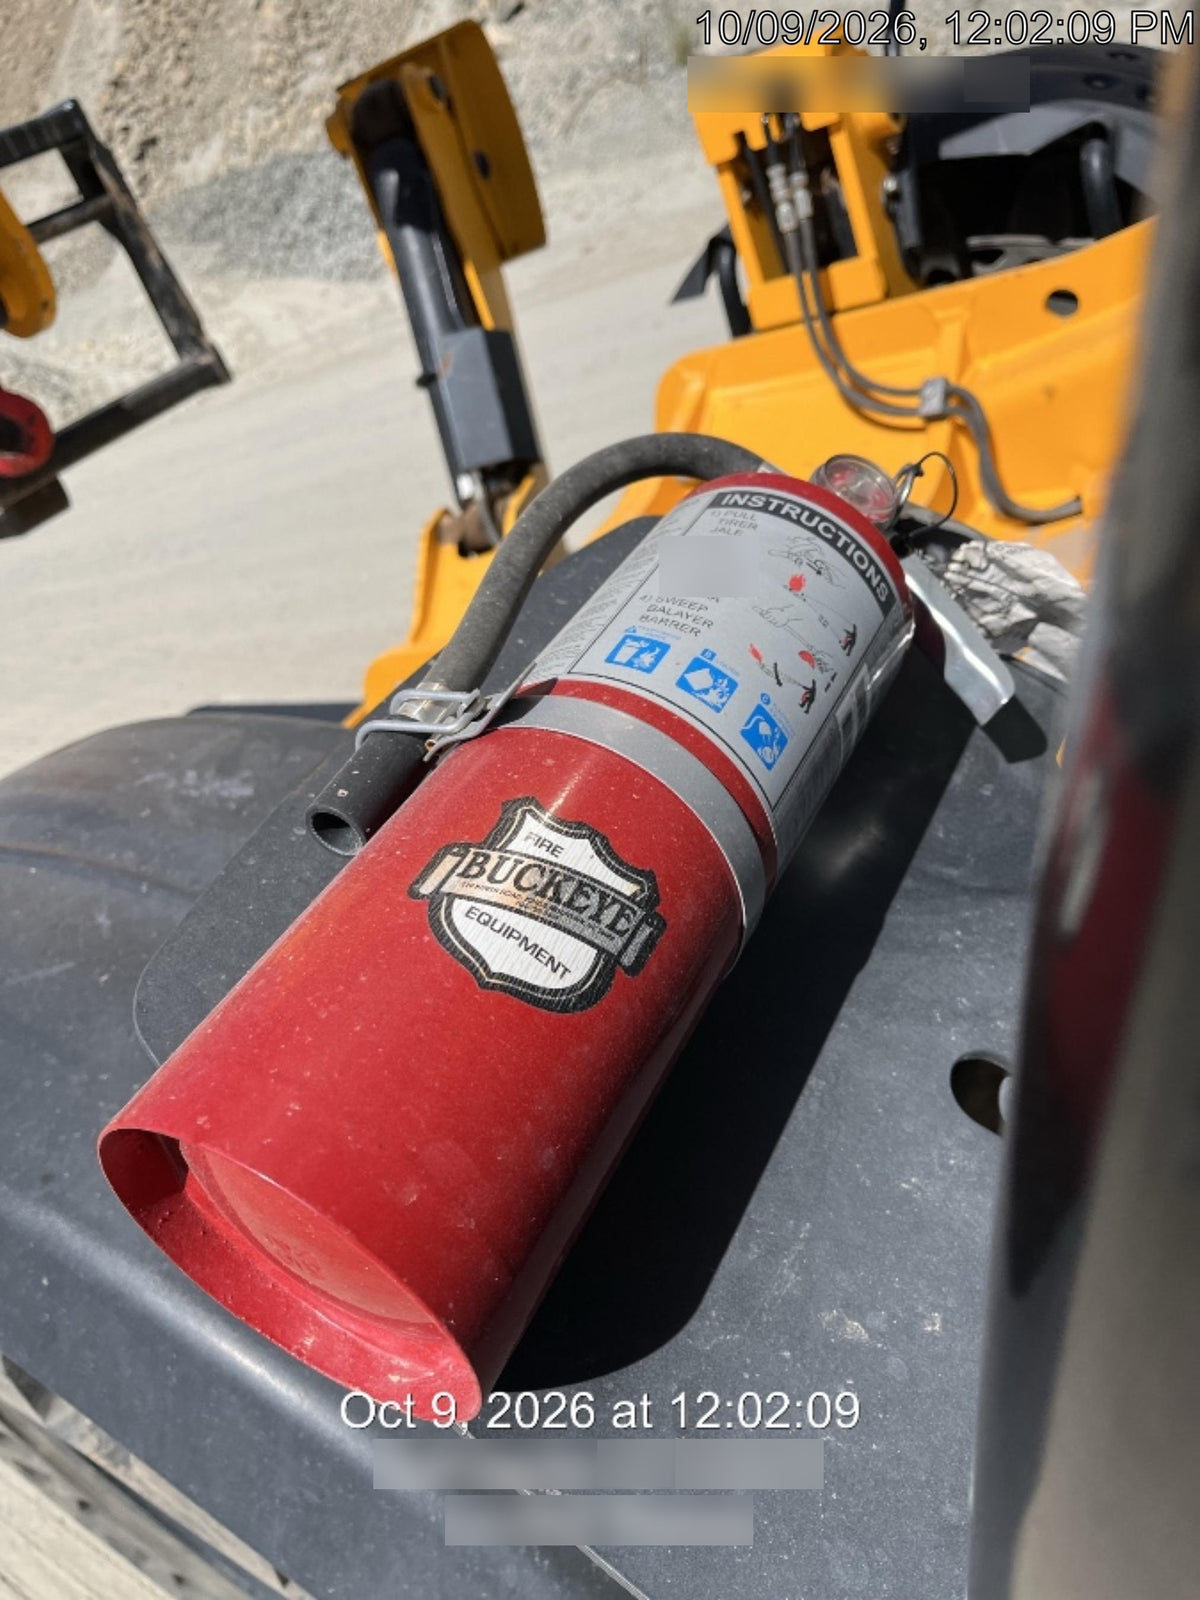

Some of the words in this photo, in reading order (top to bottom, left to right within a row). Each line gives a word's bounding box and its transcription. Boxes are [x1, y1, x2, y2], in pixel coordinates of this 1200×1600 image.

[720, 491, 890, 603] INSTRUCTIONS
[646, 603, 714, 629] BALAYER
[655, 596, 709, 612] SWEEP
[639, 614, 702, 638] BARRER
[523, 830, 565, 859] FIRE
[455, 850, 638, 940] BUCKEYE
[463, 904, 572, 981] EQUIPMENT
